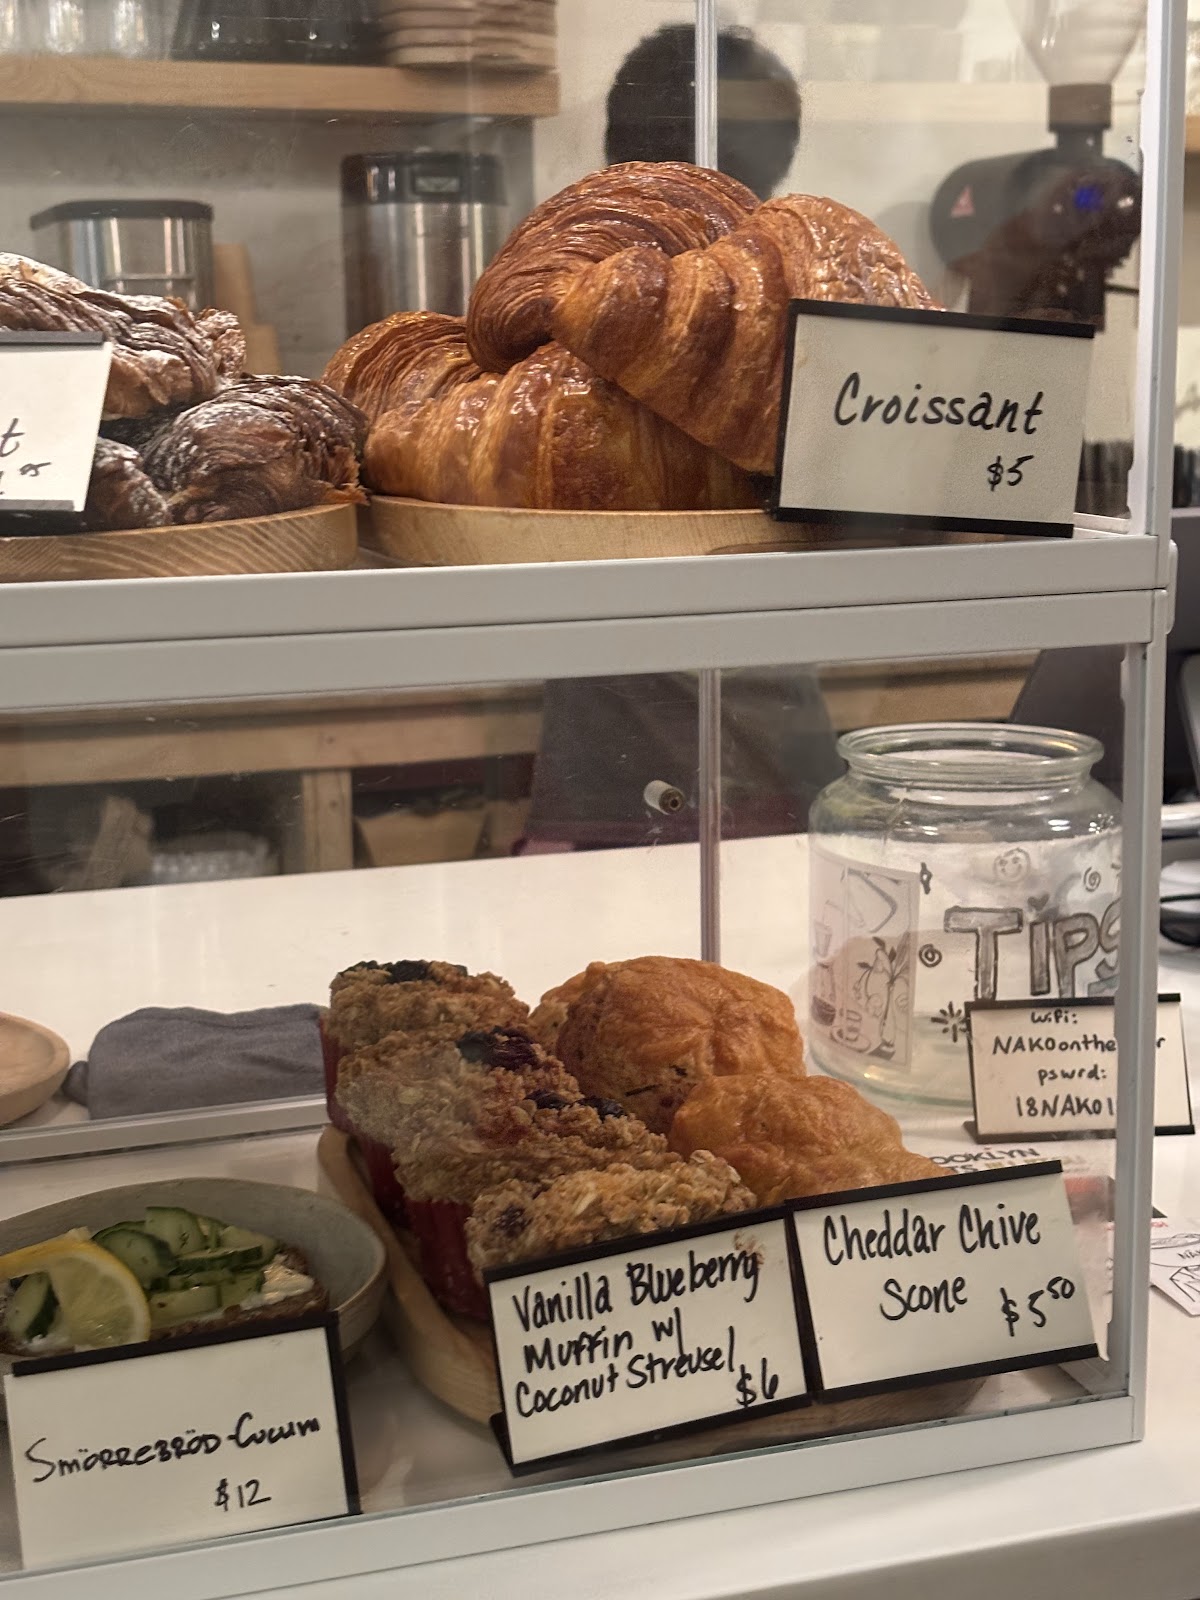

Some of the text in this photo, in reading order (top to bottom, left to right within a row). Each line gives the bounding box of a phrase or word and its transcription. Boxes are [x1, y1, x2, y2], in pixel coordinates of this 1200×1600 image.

[834, 371, 1045, 435] Croissant
[986, 455, 1034, 491] $5
[1030, 1009, 1079, 1026] wifi:
[1037, 1063, 1108, 1087] pswrd:
[823, 1203, 1041, 1265] Cheddar Chive
[512, 1249, 760, 1332] Vanilla Blueberry
[879, 1275, 968, 1320] Scone
[523, 1306, 684, 1373] Muffin w/
[515, 1325, 736, 1418] Coconut Streusel
[736, 1357, 780, 1408] $6
[214, 1478, 272, 1512] $12
